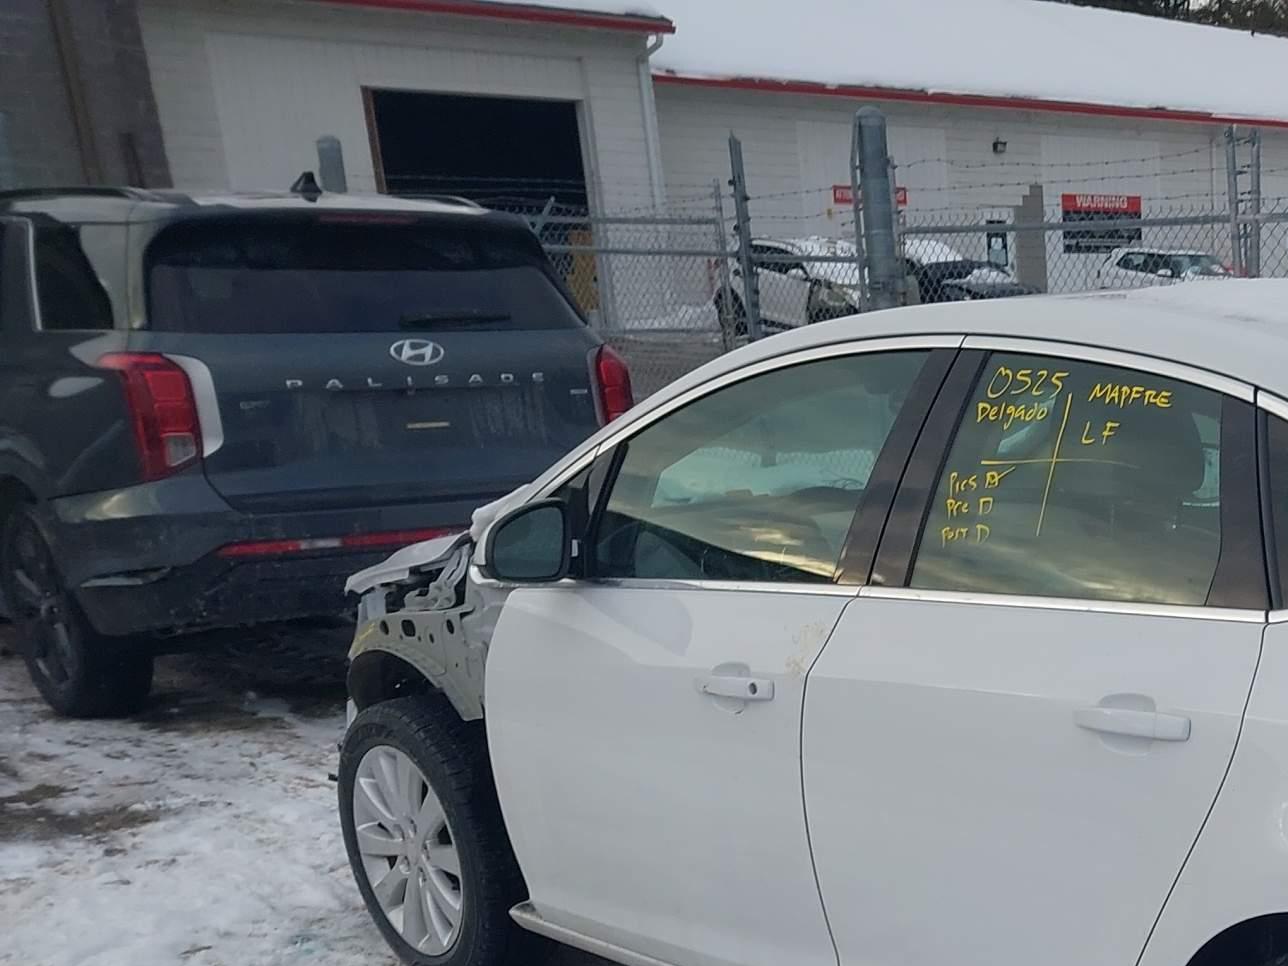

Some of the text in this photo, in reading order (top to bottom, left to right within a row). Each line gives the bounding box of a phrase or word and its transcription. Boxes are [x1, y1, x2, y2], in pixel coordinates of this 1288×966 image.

[1075, 194, 1129, 209] WARNING
[285, 372, 545, 389] PALISADE
[1088, 383, 1173, 408] MAPFRE
[976, 402, 1049, 430] Delgado
